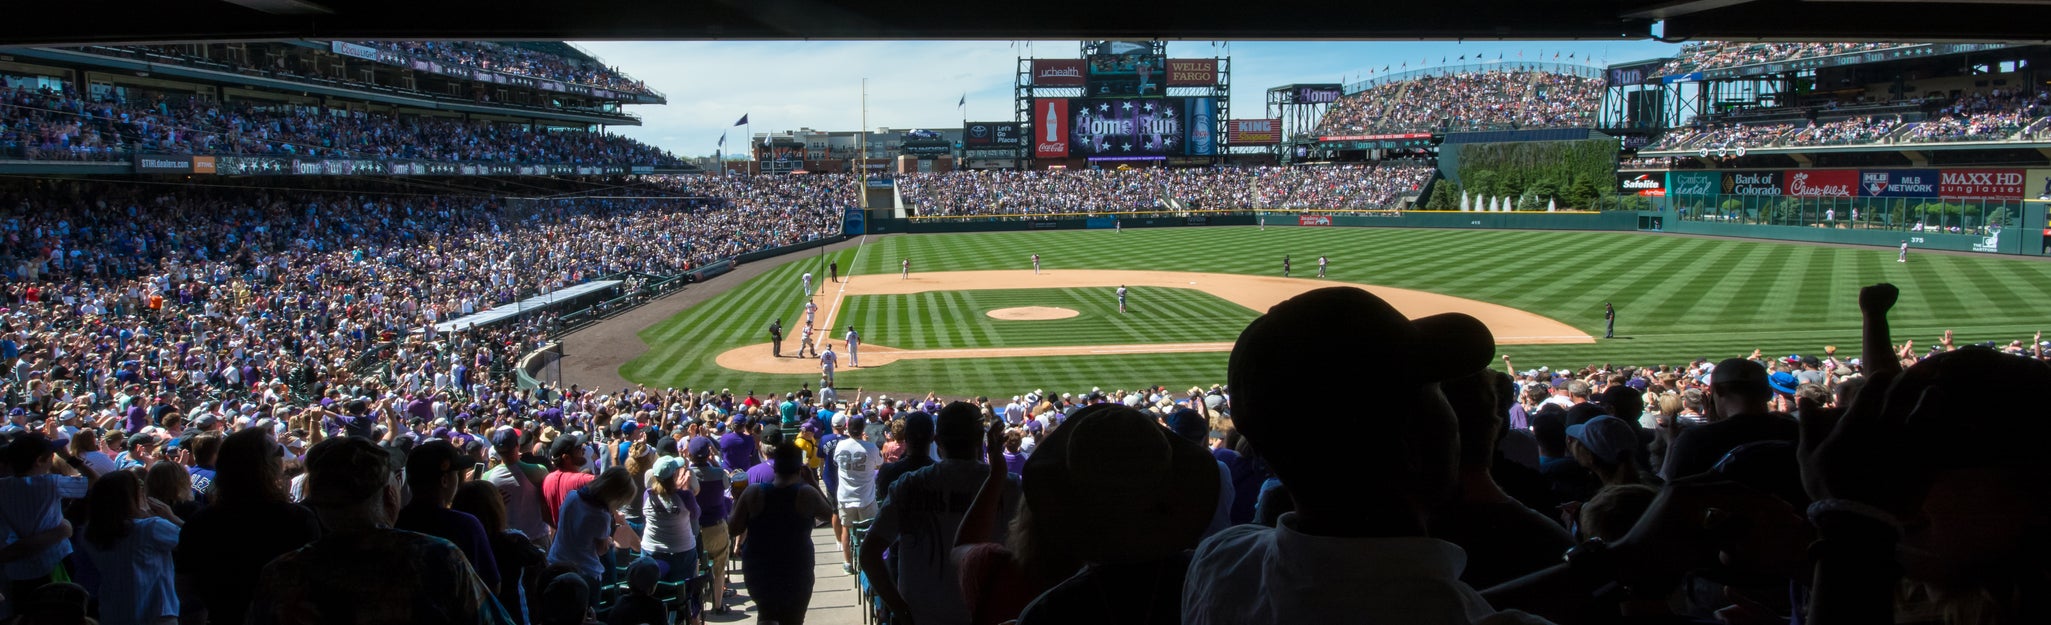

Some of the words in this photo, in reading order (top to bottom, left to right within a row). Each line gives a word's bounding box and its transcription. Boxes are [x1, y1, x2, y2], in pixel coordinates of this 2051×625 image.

[361, 49, 376, 60] LIGHT
[1836, 55, 1862, 65] Home
[1866, 52, 1884, 62] Run
[1041, 66, 1078, 77] uchealth
[1172, 63, 1211, 72] WELLS
[1173, 72, 1211, 81] FARGO
[1612, 69, 1641, 85] Run
[1300, 88, 1340, 103] Home
[1076, 115, 1133, 135] Home
[1138, 115, 1177, 135] Run
[1238, 121, 1272, 132] KING
[141, 158, 189, 169] STIHLdealers.com
[292, 159, 321, 174] Home
[322, 159, 342, 174] Run
[387, 161, 409, 174] Home
[410, 162, 425, 174] Run
[1678, 173, 1708, 184] Comfort
[1735, 174, 1760, 184] Bank
[1762, 173, 1773, 184] of
[1942, 173, 1993, 185] MAXX
[1996, 173, 2022, 185] HD
[1623, 180, 1659, 189] Safelite
[1675, 181, 1711, 195] dental
[1735, 185, 1781, 195] Colorado
